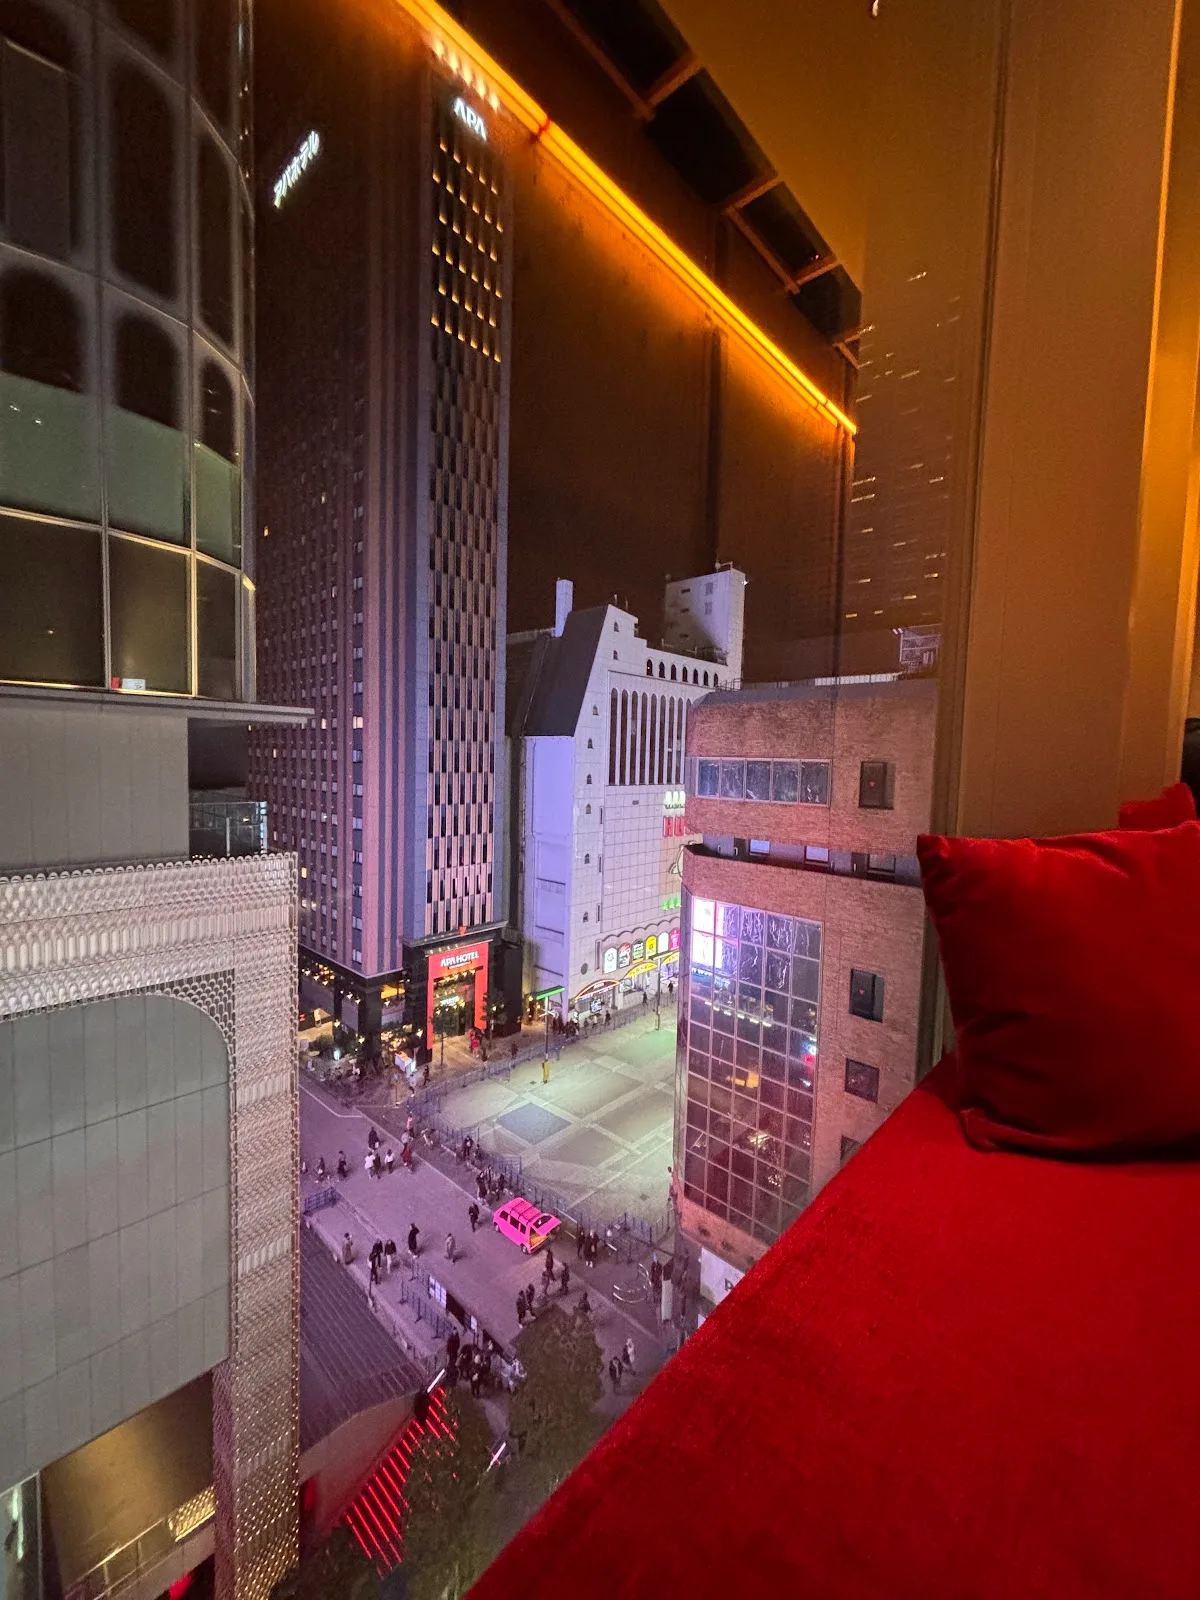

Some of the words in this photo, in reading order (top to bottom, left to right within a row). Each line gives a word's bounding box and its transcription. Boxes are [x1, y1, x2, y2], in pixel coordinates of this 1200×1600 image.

[454, 98, 487, 141] APA
[273, 130, 320, 209] アパホテル
[440, 956, 456, 967] APA
[455, 951, 480, 964] HOTEL
